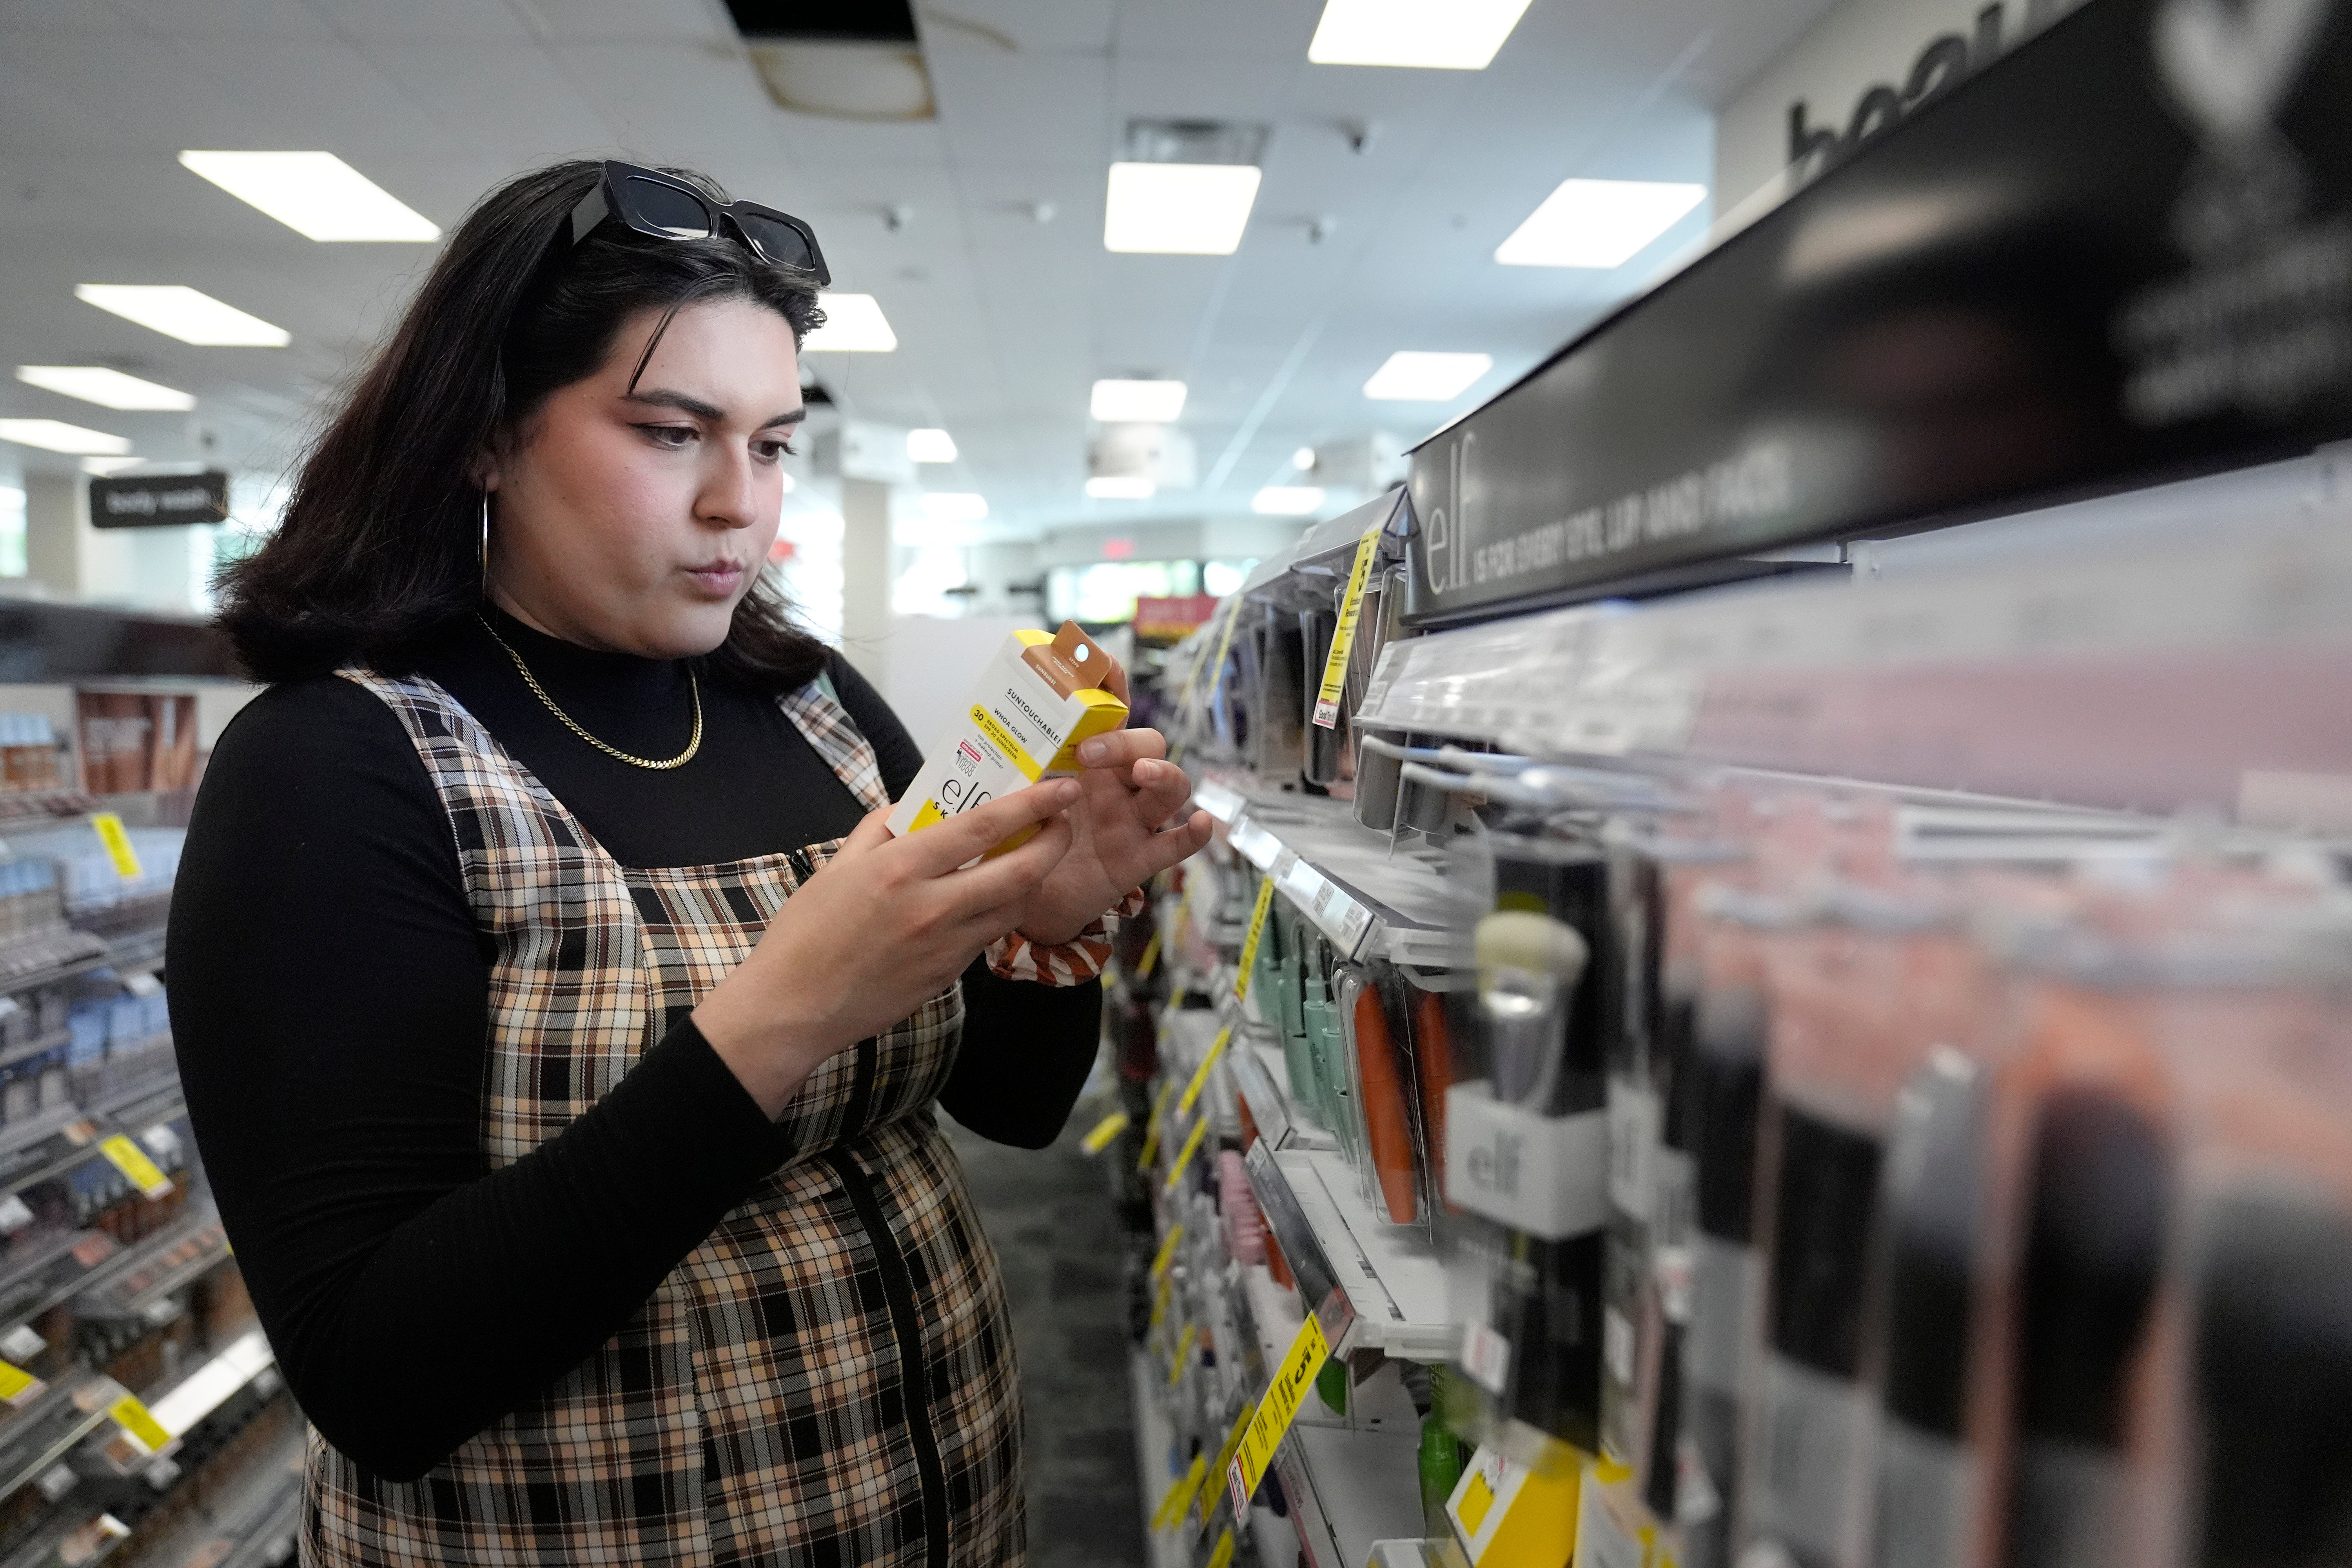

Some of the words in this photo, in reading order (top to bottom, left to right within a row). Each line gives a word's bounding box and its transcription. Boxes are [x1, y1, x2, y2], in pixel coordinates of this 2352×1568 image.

[1035, 664, 1057, 685] SUNBURST
[974, 710, 984, 720] 30
[995, 708, 1011, 727] WHOA
[1011, 726, 1027, 743] GLOW
[1007, 688, 1061, 744] SUNTOUCHABLE!
[1318, 709, 1327, 720] Good
[987, 719, 1000, 733] BROAD
[1000, 733, 1018, 753] SPECTRUM
[978, 742, 992, 757] makeup
[991, 757, 1004, 769] primer
[984, 741, 1002, 760] protection
[996, 737, 1018, 760] SUNSCREEN
